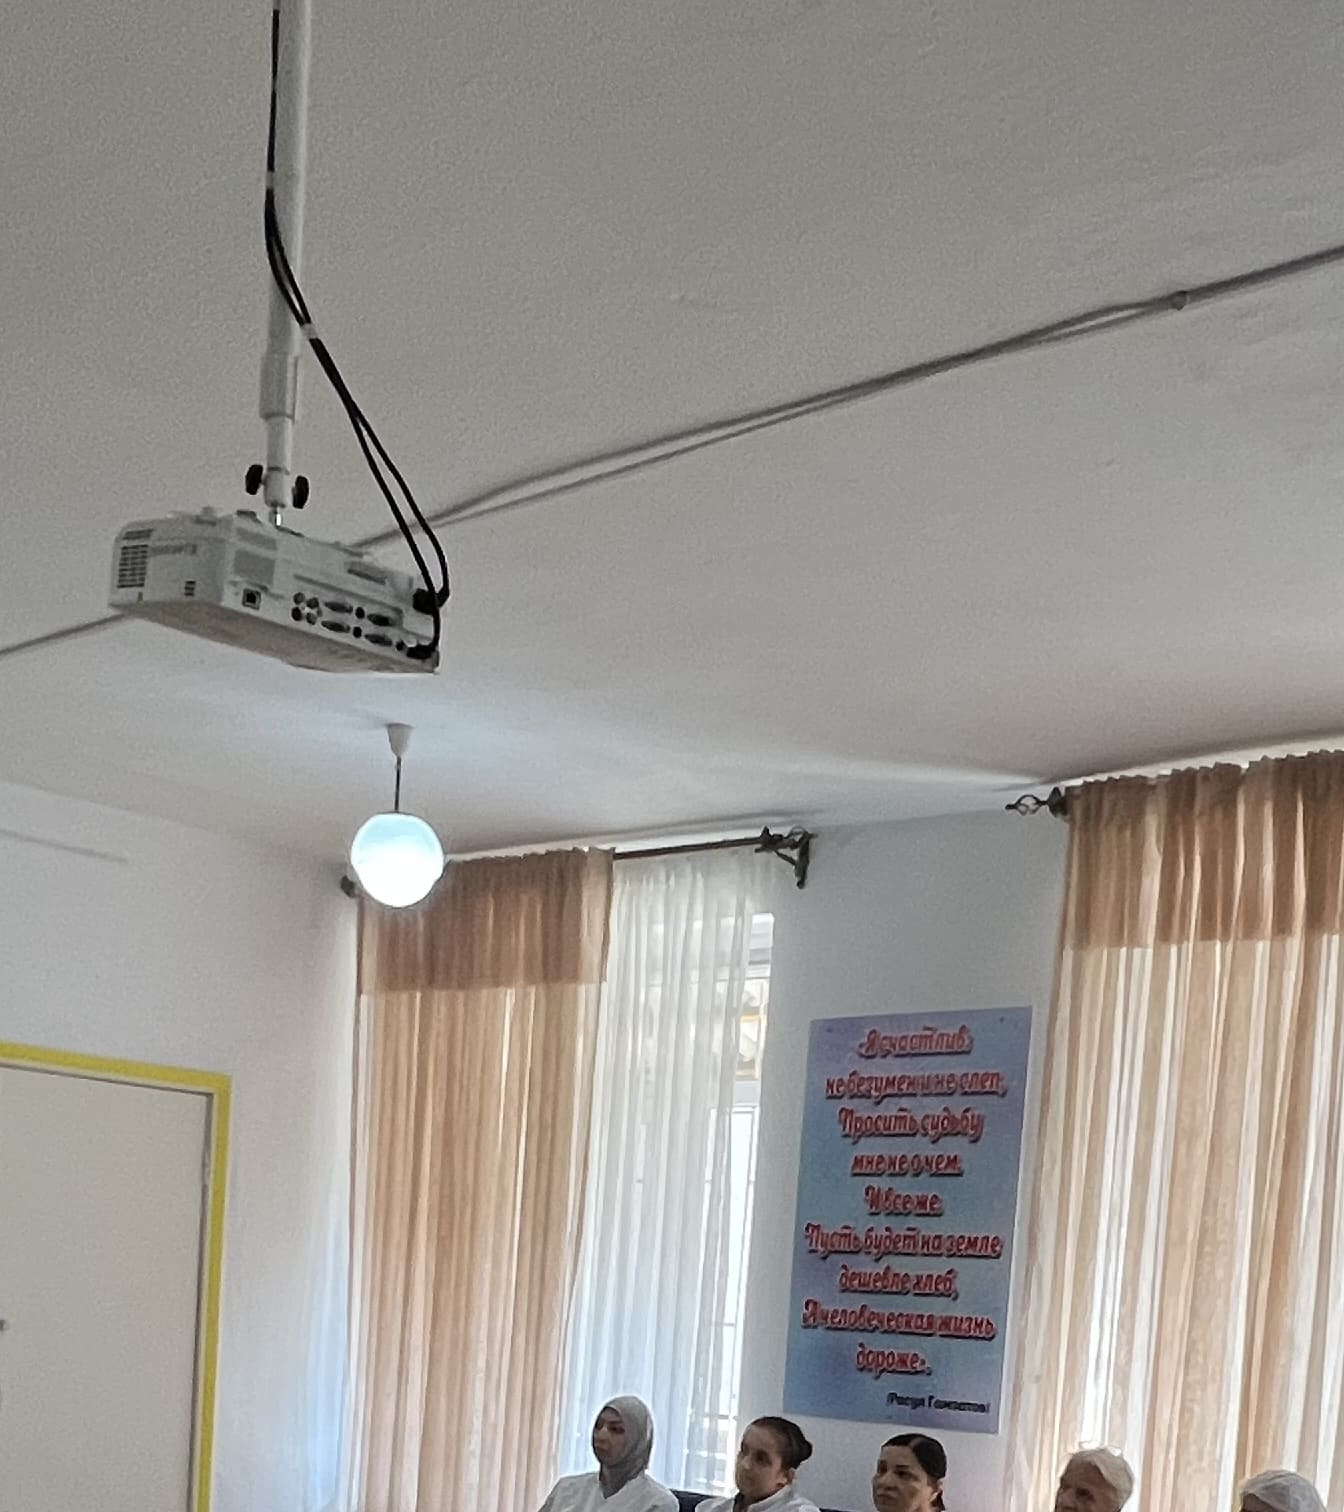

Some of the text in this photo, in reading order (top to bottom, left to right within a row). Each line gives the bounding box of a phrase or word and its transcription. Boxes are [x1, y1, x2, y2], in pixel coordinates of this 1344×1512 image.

[839, 1105, 984, 1143] Просить судьбу
[852, 1154, 885, 1176] мне
[887, 1154, 908, 1176] не
[910, 1154, 923, 1176] о
[864, 1184, 882, 1215] И
[883, 1187, 914, 1215] все
[805, 1222, 1002, 1261] Пусть будет на земле
[839, 1264, 910, 1294] дешевле
[822, 1304, 936, 1337] человеческая
[937, 1311, 997, 1341] жизнь
